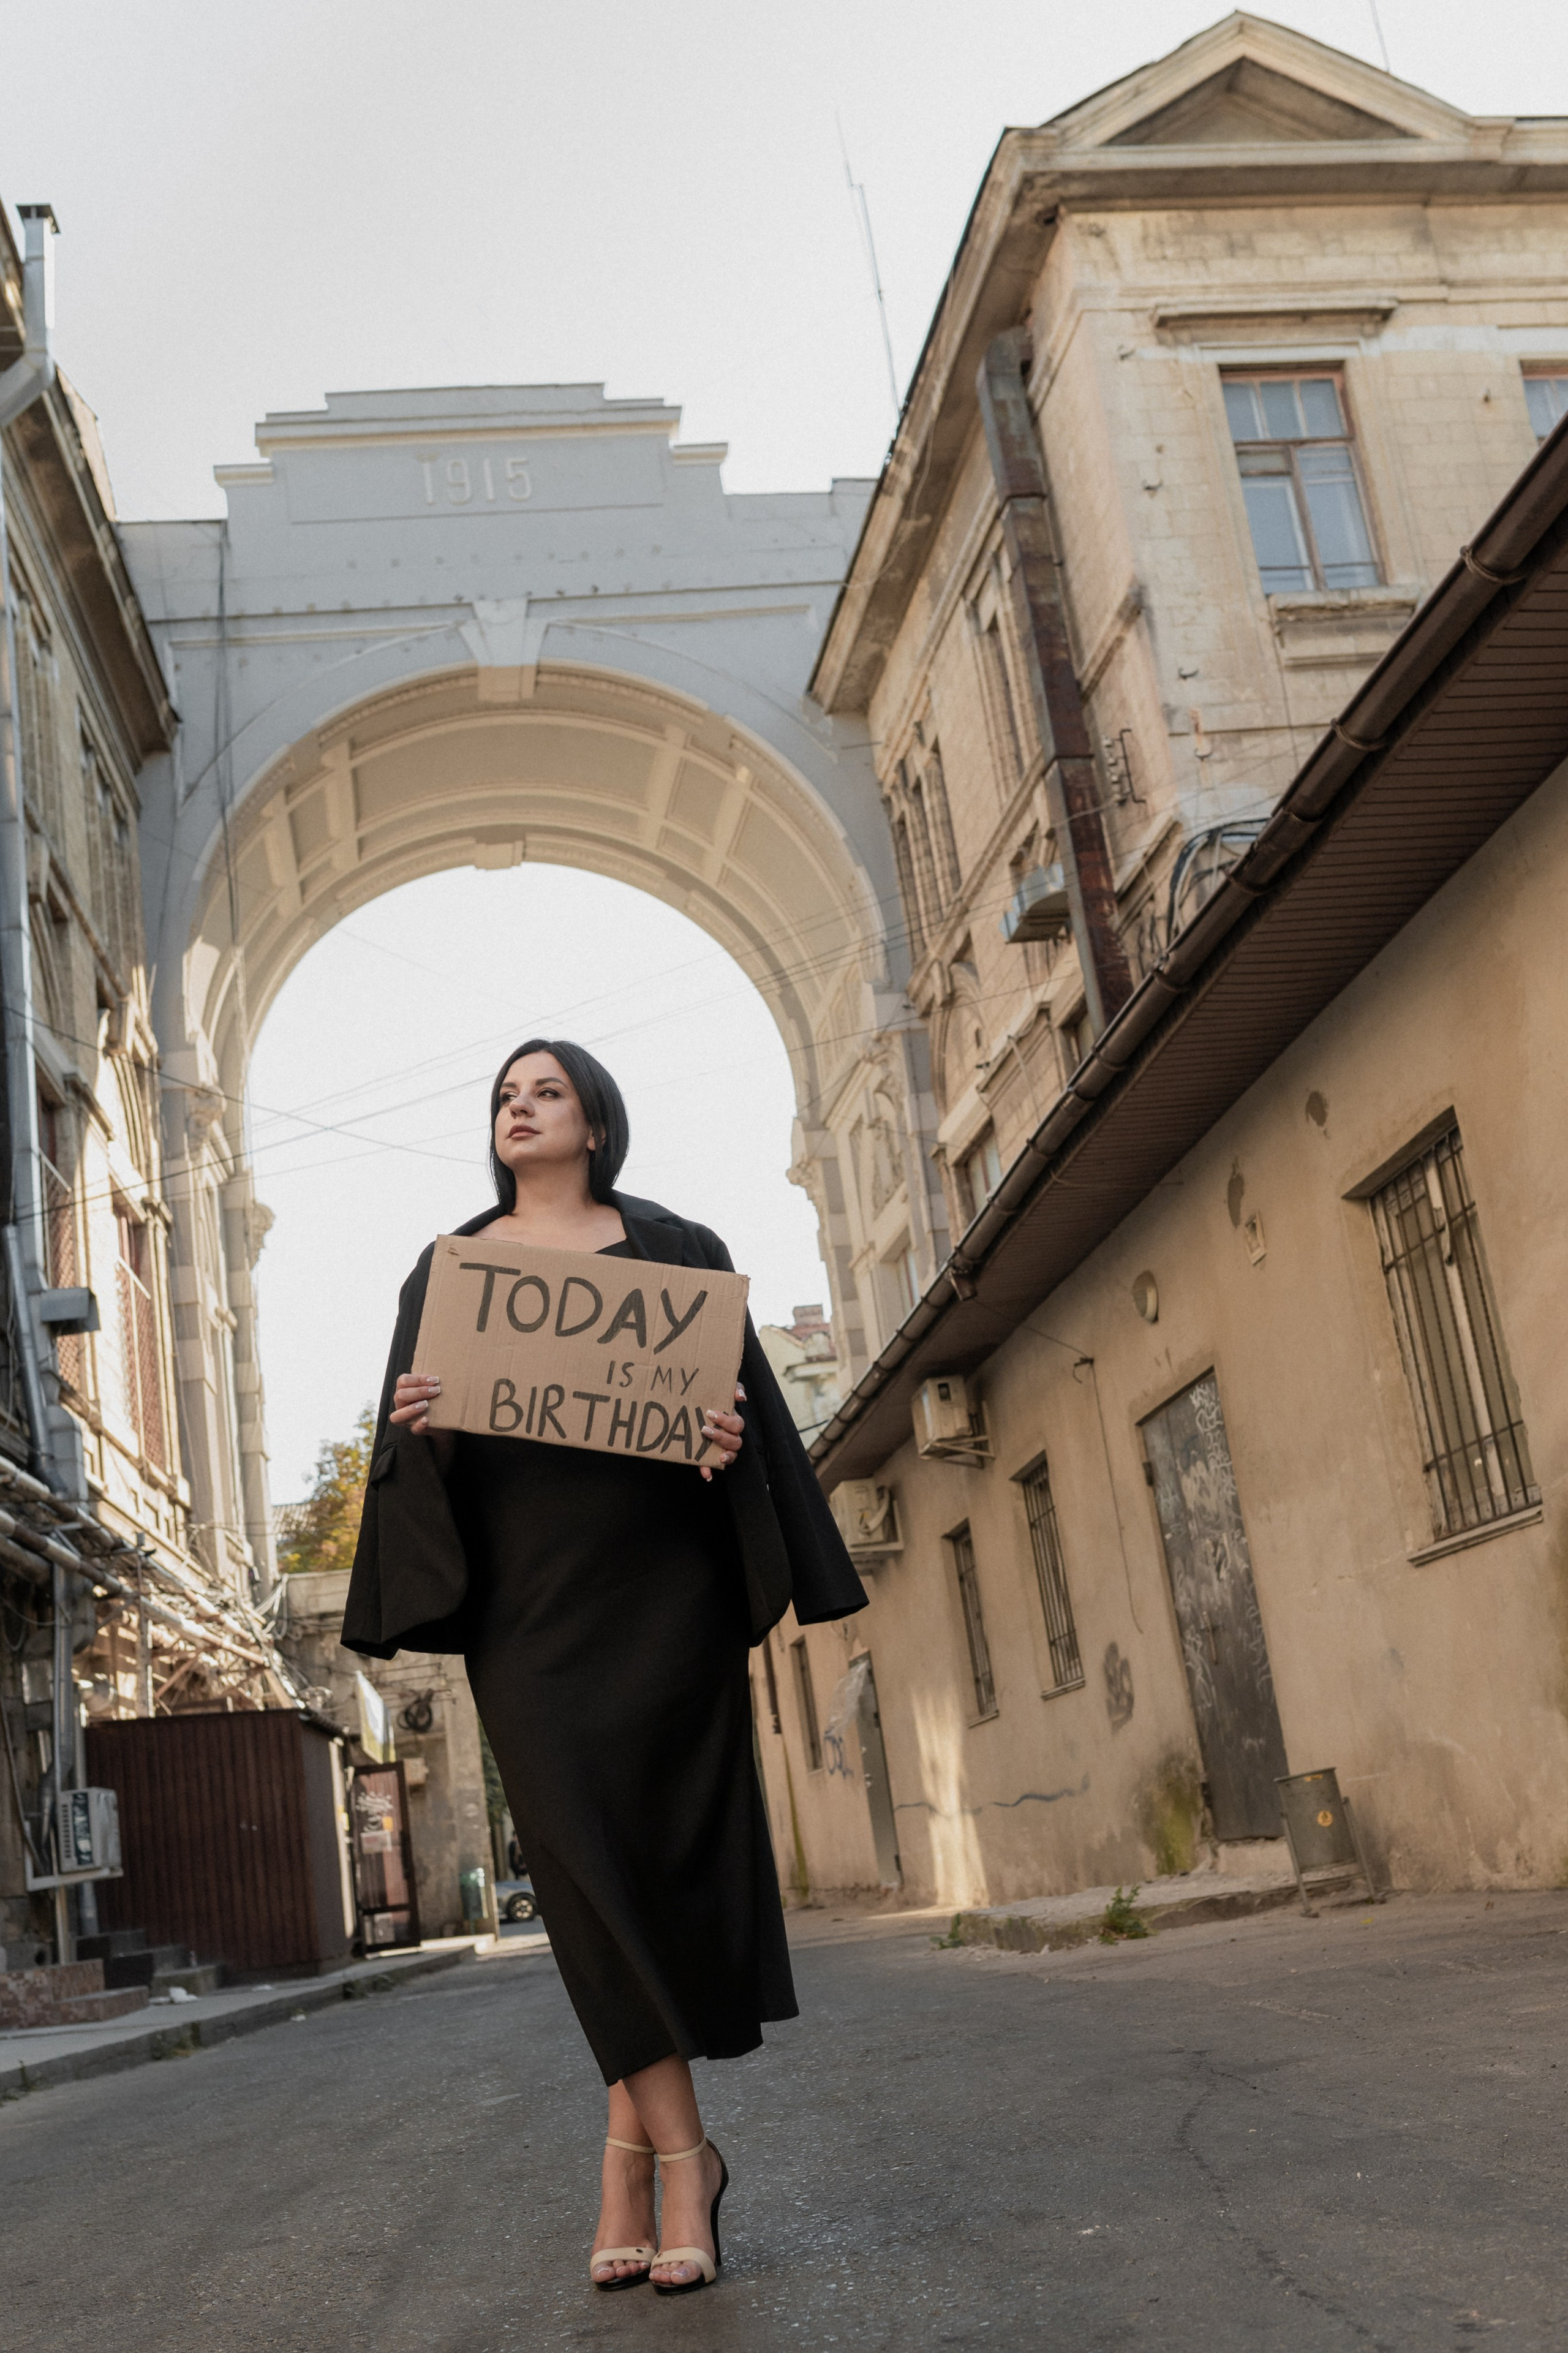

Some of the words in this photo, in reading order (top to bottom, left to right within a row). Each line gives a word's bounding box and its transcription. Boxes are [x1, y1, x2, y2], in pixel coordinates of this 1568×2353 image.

[416, 452, 532, 506] 1915
[459, 1262, 709, 1355] TODAY
[606, 1359, 635, 1388] IS
[650, 1365, 699, 1397] MY
[489, 1378, 729, 1462] BIRTHDAY
